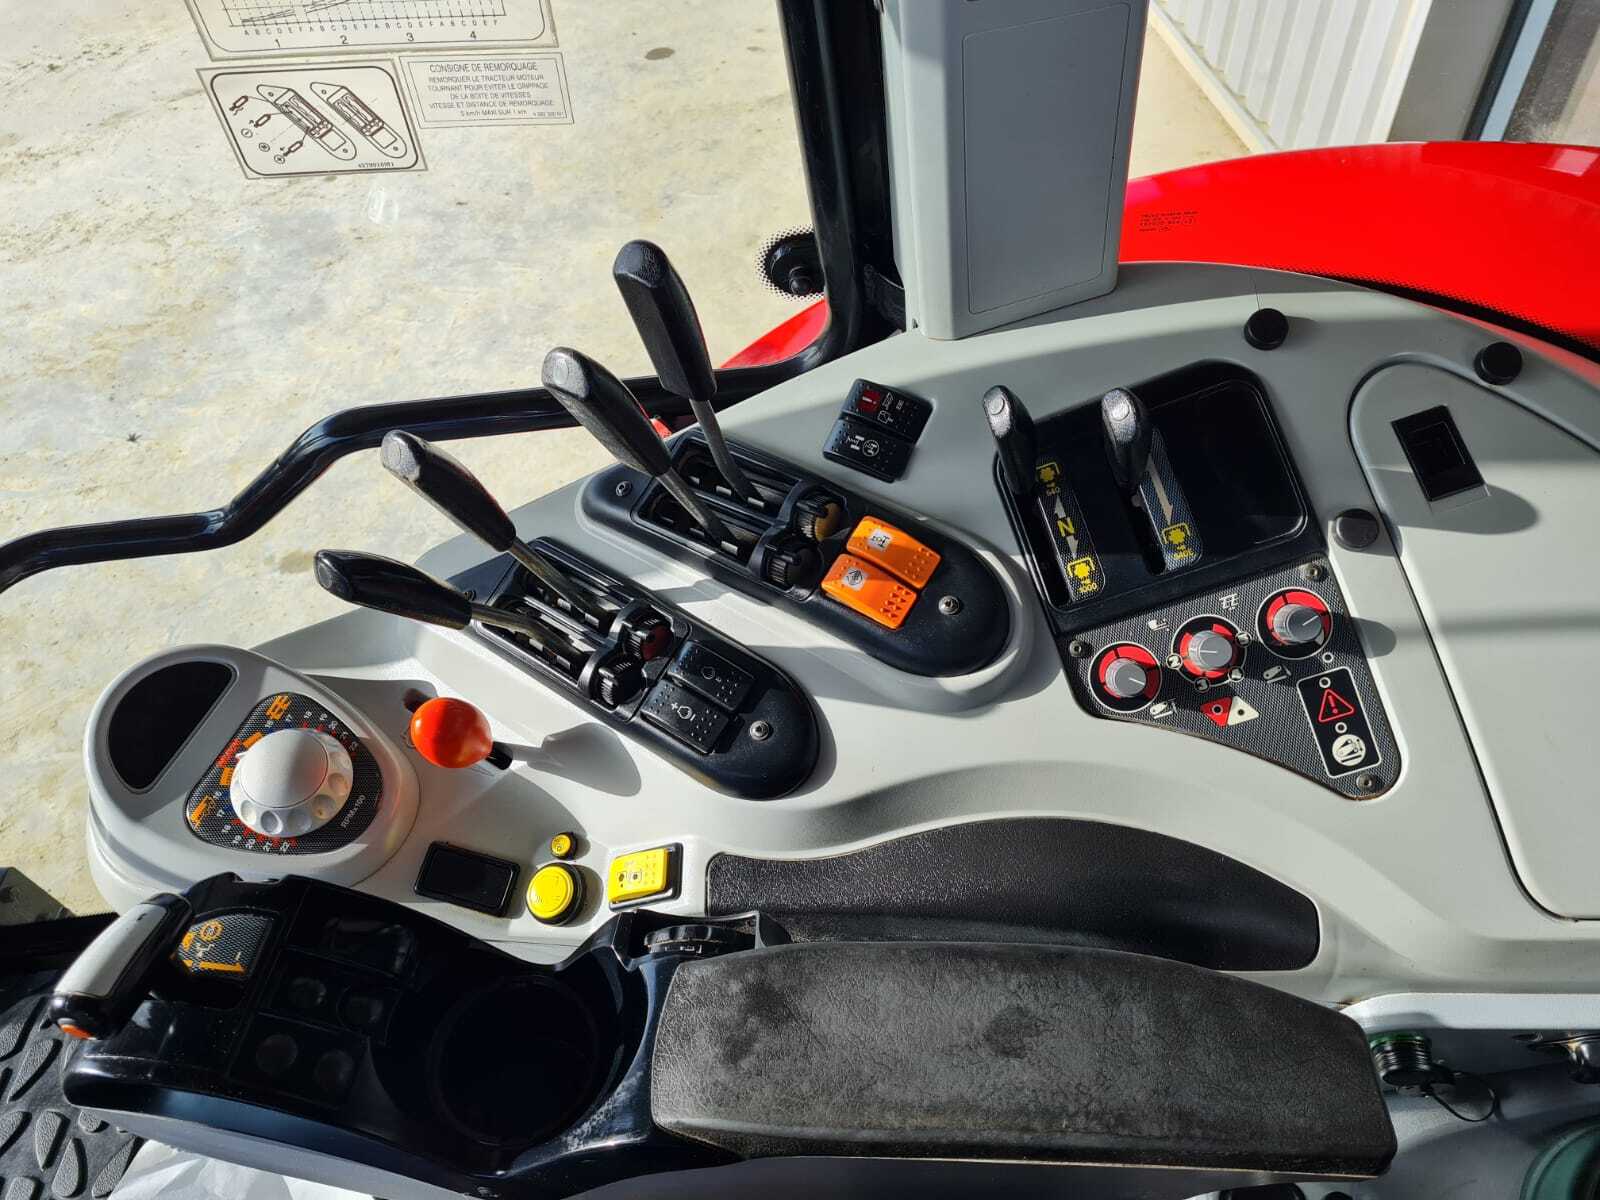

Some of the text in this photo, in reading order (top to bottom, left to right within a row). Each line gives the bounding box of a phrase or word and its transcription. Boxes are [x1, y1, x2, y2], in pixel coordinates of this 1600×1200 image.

[275, 31, 477, 48] 1 2 3 4
[429, 62, 538, 73] CONSIGNE DE REMORQUAGE
[1058, 518, 1074, 538] N
[1238, 634, 1249, 643] 5
[1170, 656, 1180, 668] 2
[1198, 680, 1208, 690] 3
